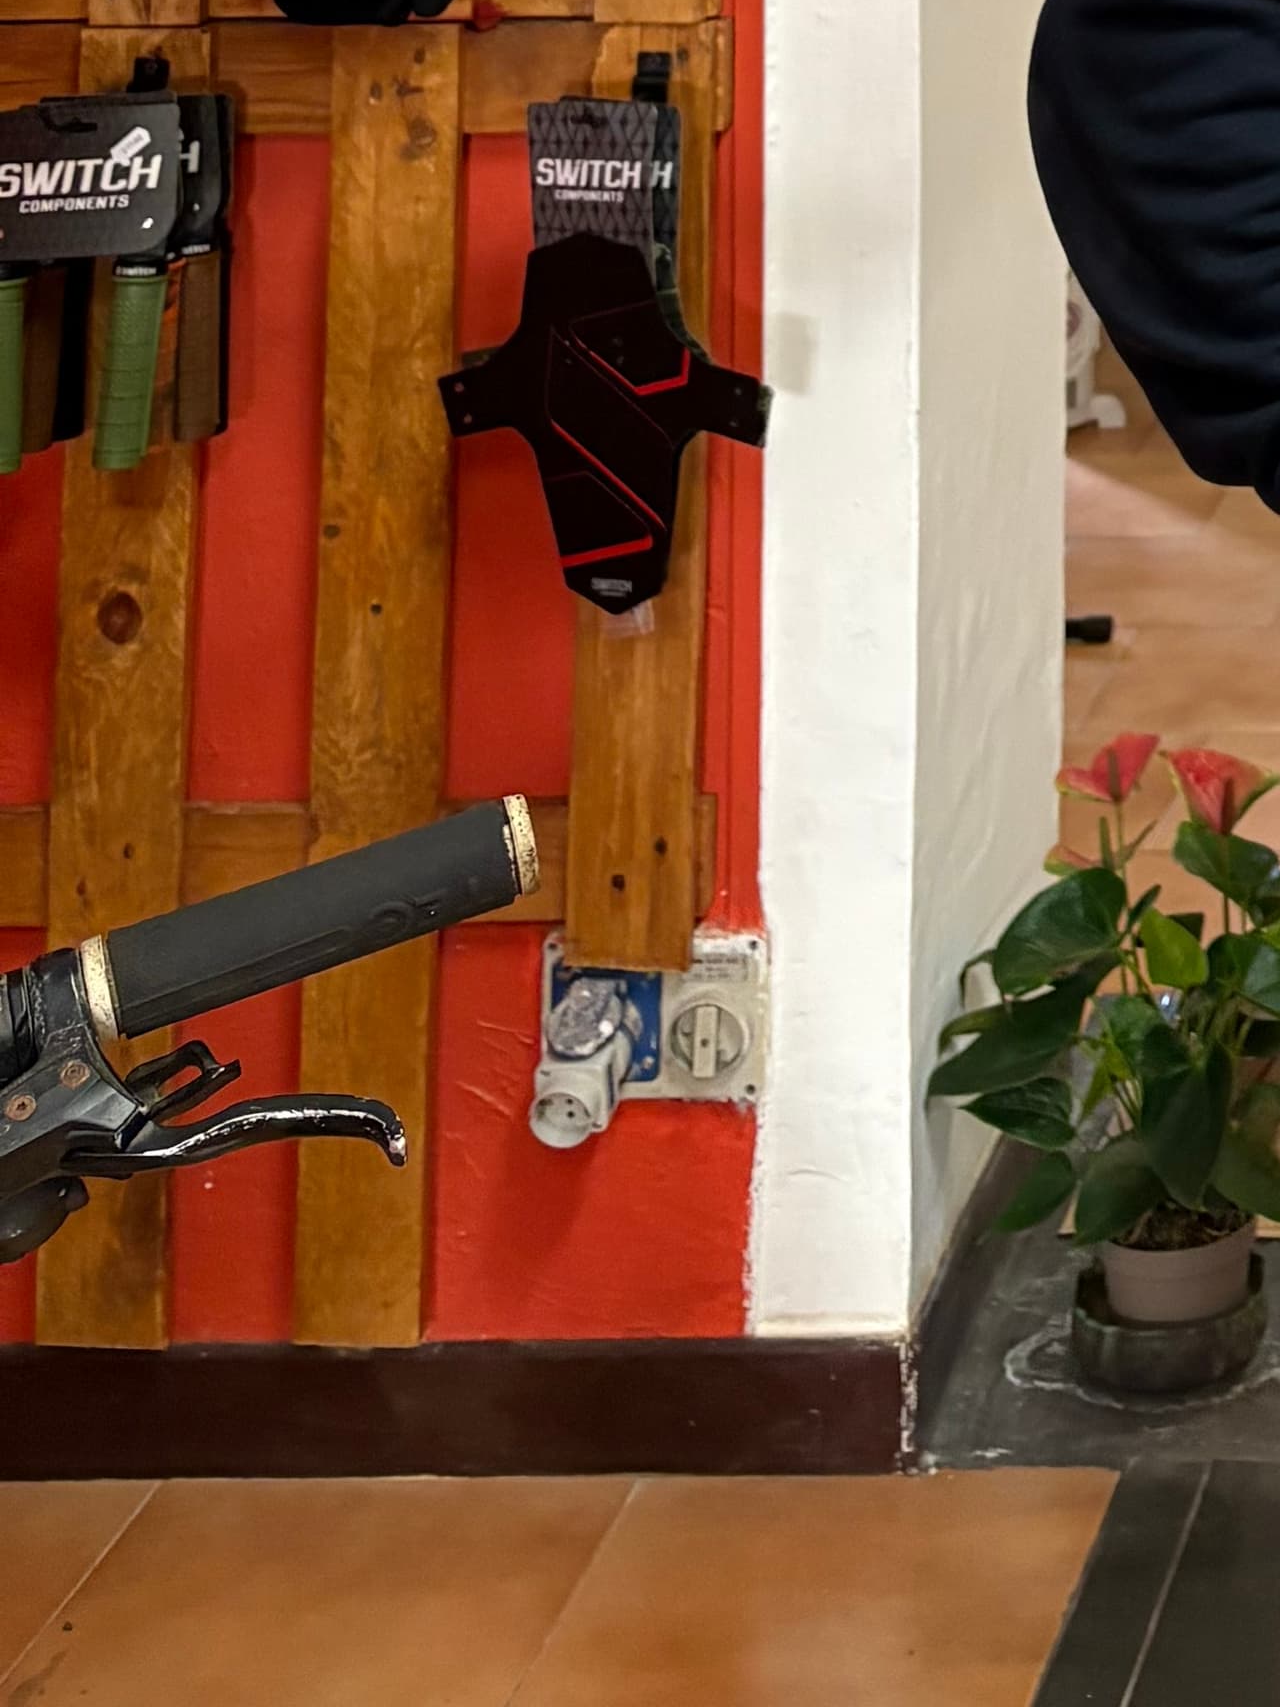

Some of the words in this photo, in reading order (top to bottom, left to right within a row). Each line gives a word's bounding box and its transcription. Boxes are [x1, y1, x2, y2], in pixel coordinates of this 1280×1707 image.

[0, 154, 162, 198] SWITCH
[535, 158, 642, 189] SWITCH
[19, 193, 130, 215] COMPONENTS
[554, 189, 624, 203] COMPONENTS
